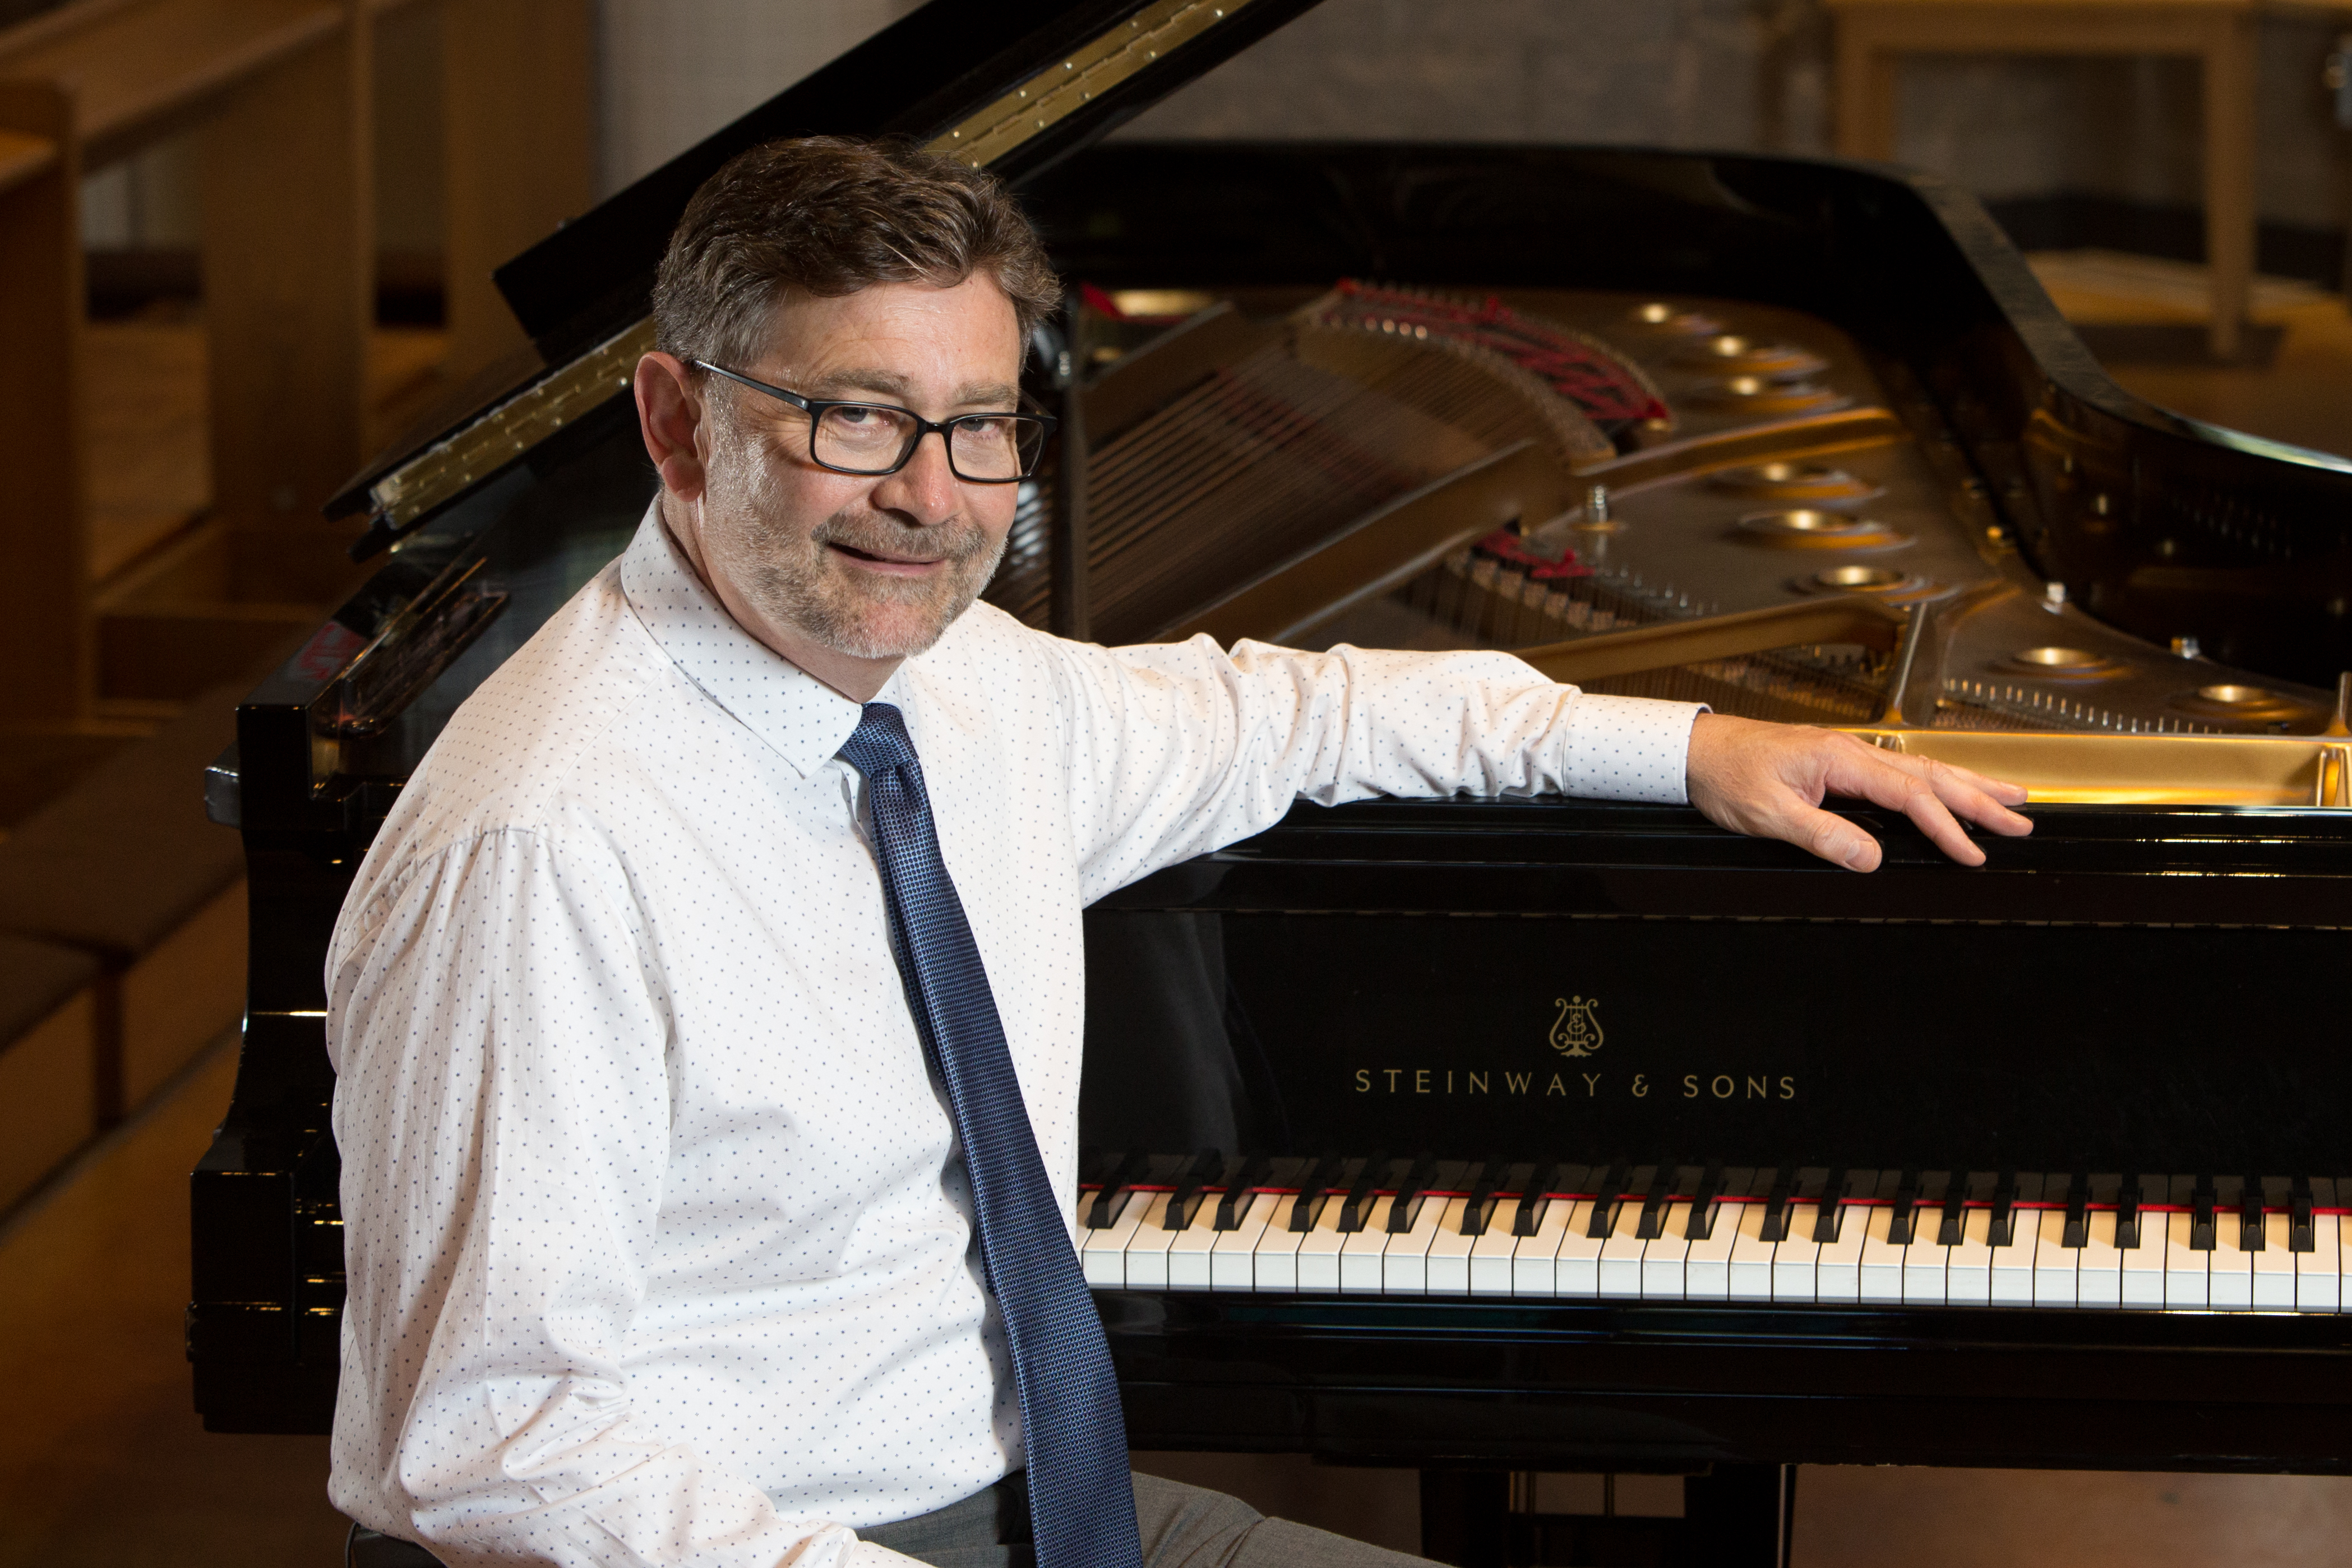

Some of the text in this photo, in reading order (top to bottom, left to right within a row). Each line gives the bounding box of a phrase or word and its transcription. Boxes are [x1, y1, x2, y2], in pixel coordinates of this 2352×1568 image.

[1355, 1069, 1795, 1099] STEINWAY & SONS
